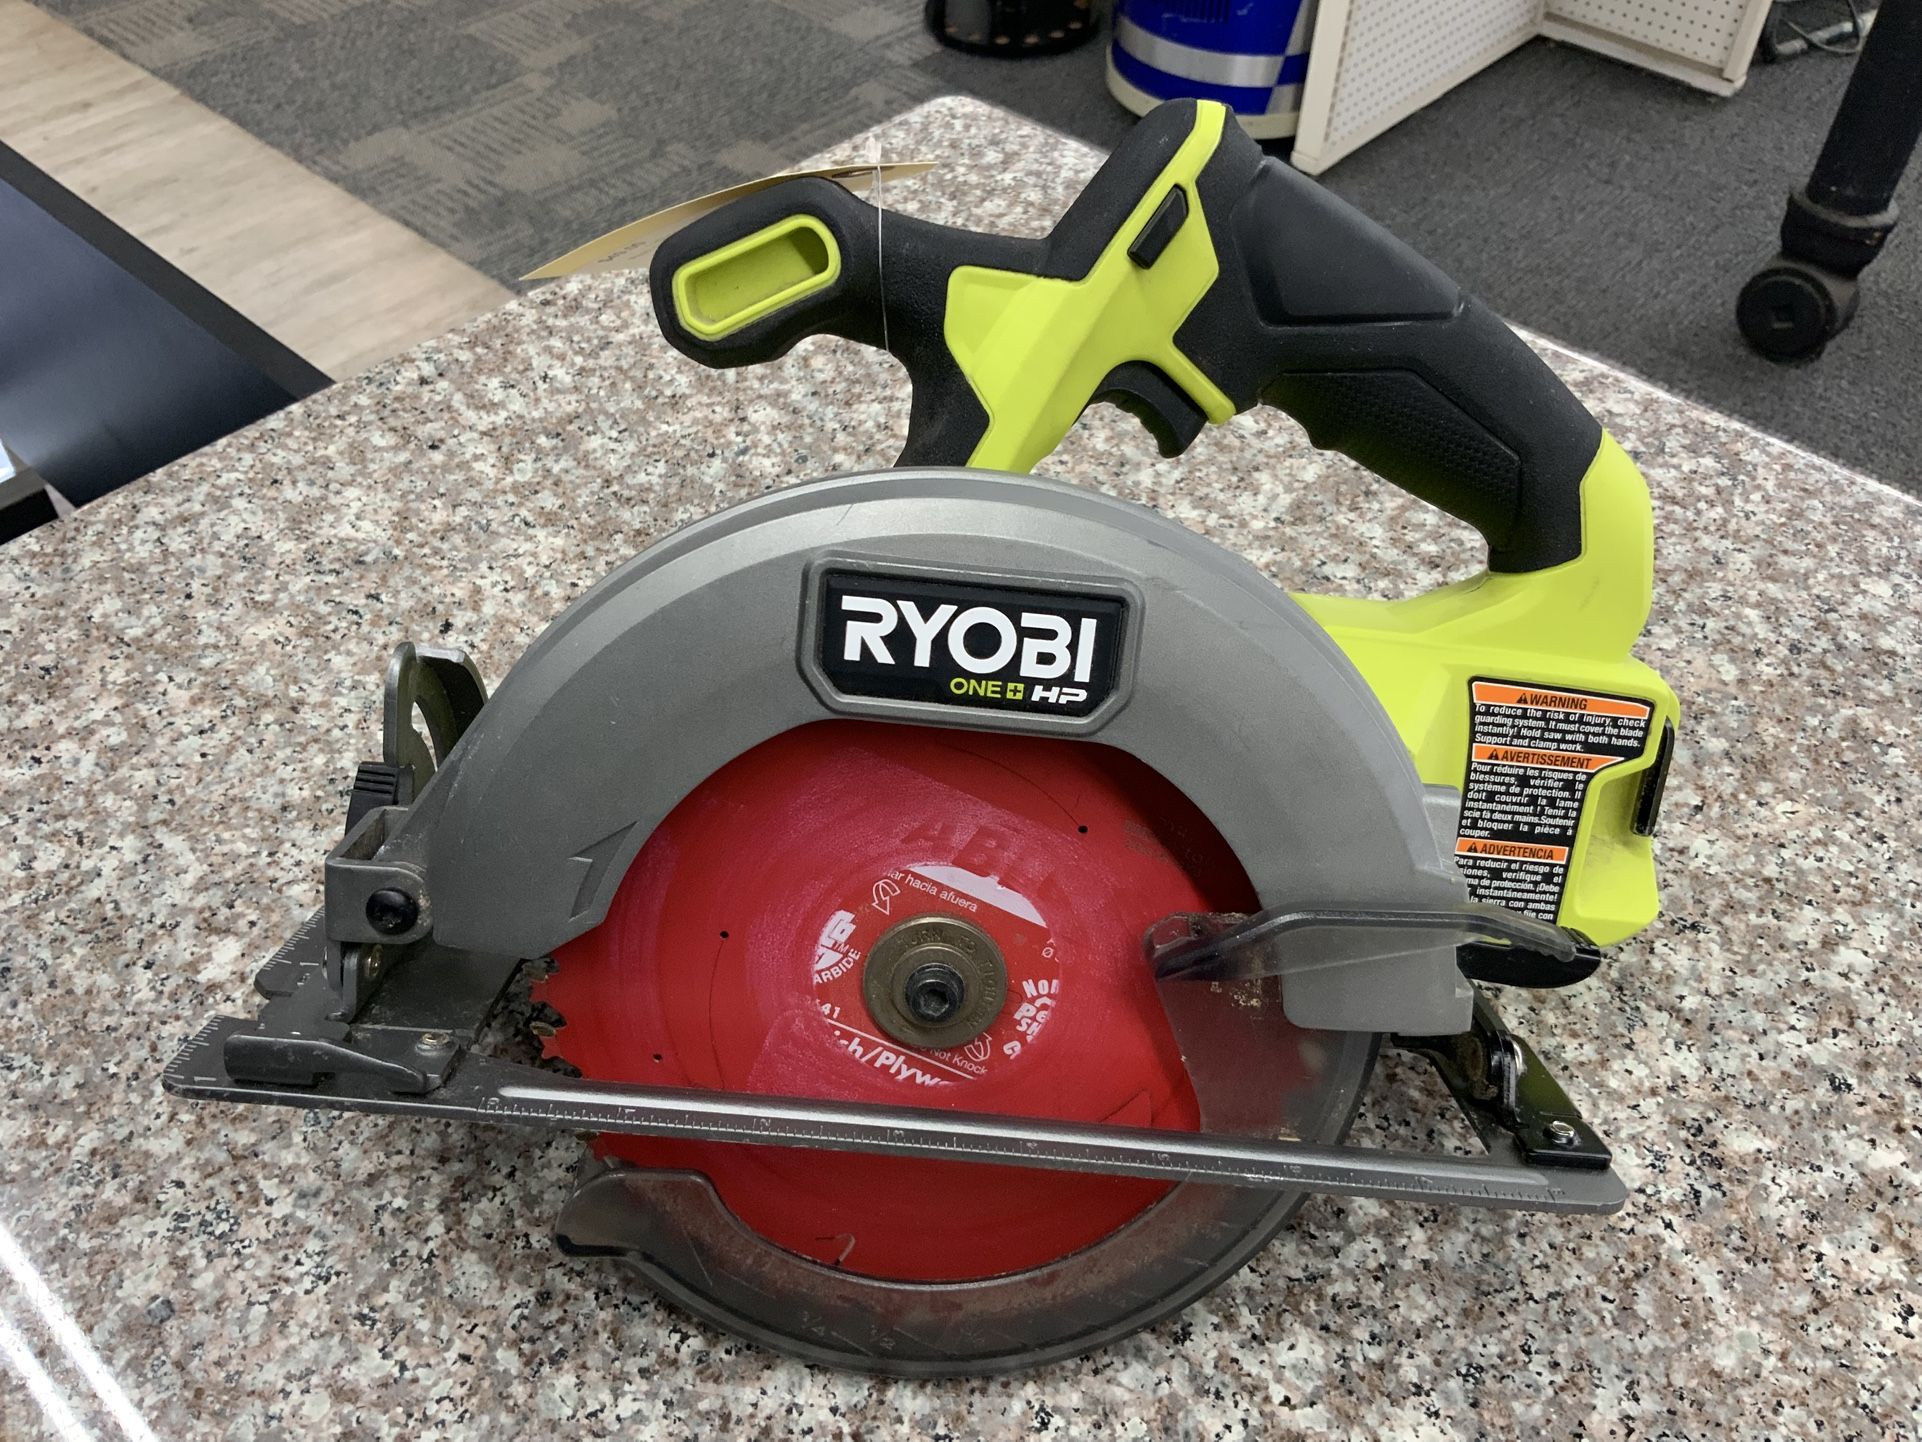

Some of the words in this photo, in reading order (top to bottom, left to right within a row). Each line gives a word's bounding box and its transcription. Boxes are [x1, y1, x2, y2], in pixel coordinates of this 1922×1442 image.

[841, 595, 1097, 683] RYOBI
[1030, 685, 1088, 705] HP
[1529, 693, 1588, 711] WARNING
[1475, 703, 1486, 713] To
[1489, 705, 1522, 716] reduce
[1526, 708, 1542, 718] the
[1546, 710, 1565, 720] risk
[1569, 712, 1579, 721] of
[1583, 713, 1612, 726] injury,
[1617, 717, 1646, 728] check
[1474, 714, 1513, 727] guarding
[1514, 718, 1547, 728] system.
[1549, 721, 1555, 729] It
[1556, 722, 1579, 731] must
[1580, 725, 1604, 734] cover
[1605, 726, 1619, 735] the
[1619, 727, 1644, 738] blade
[1474, 723, 1517, 737] instantly!
[1520, 727, 1541, 738] Hold
[1544, 732, 1562, 740] saw
[1565, 733, 1585, 742] with
[1588, 734, 1609, 744] both
[1611, 736, 1640, 747] hands.
[1474, 733, 1511, 745] Support
[1512, 738, 1531, 746] and
[1530, 739, 1558, 750] clamp
[1560, 742, 1584, 752] work.
[1501, 750, 1592, 769] AVERTISSEMENT
[1470, 772, 1518, 785] blessures,
[1530, 778, 1564, 788] vérifier
[1575, 781, 1584, 790] le
[1471, 762, 1491, 772] Pour
[1493, 764, 1524, 775] réduire
[1526, 767, 1539, 777] les
[1541, 770, 1573, 782] risques
[1575, 772, 1586, 781] de
[1467, 791, 1486, 800] doit
[1495, 794, 1528, 804] couvrir
[1537, 796, 1547, 805] la
[1555, 798, 1579, 808] lame
[1468, 782, 1507, 793] système
[1509, 785, 1520, 794] de
[1523, 787, 1571, 799] protection.
[1463, 809, 1480, 818] scie
[1492, 812, 1512, 821] deux
[1465, 799, 1534, 814] instantanément
[1544, 806, 1565, 817] Tenir
[1568, 809, 1577, 818] la
[1459, 828, 1491, 838] couper.
[1461, 818, 1471, 827] et
[1477, 820, 1513, 831] bloquer
[1519, 823, 1529, 832] la
[1534, 825, 1560, 835] pièce
[1566, 827, 1573, 836] à
[1479, 844, 1554, 860] ADVERTENCIA
[1454, 856, 1473, 866] Para
[1476, 859, 1508, 869] reducir
[1510, 862, 1519, 870] el
[1522, 863, 1550, 874] riesgo
[1552, 865, 1564, 874] de
[1459, 866, 1491, 878] siones,
[1502, 870, 1542, 883] verifique
[1553, 875, 1562, 883] el
[905, 874, 938, 896] hacia
[940, 890, 978, 913] afuera
[1480, 878, 1490, 886] de
[1491, 880, 1535, 891] protección.
[1476, 887, 1558, 902] instantáneamente!
[1508, 900, 1524, 908] con
[1527, 902, 1556, 911] ambas
[1538, 912, 1553, 920] con
[812, 948, 862, 985] ARBIDE
[929, 1047, 951, 1063] Not
[952, 1053, 988, 1075] Knock
